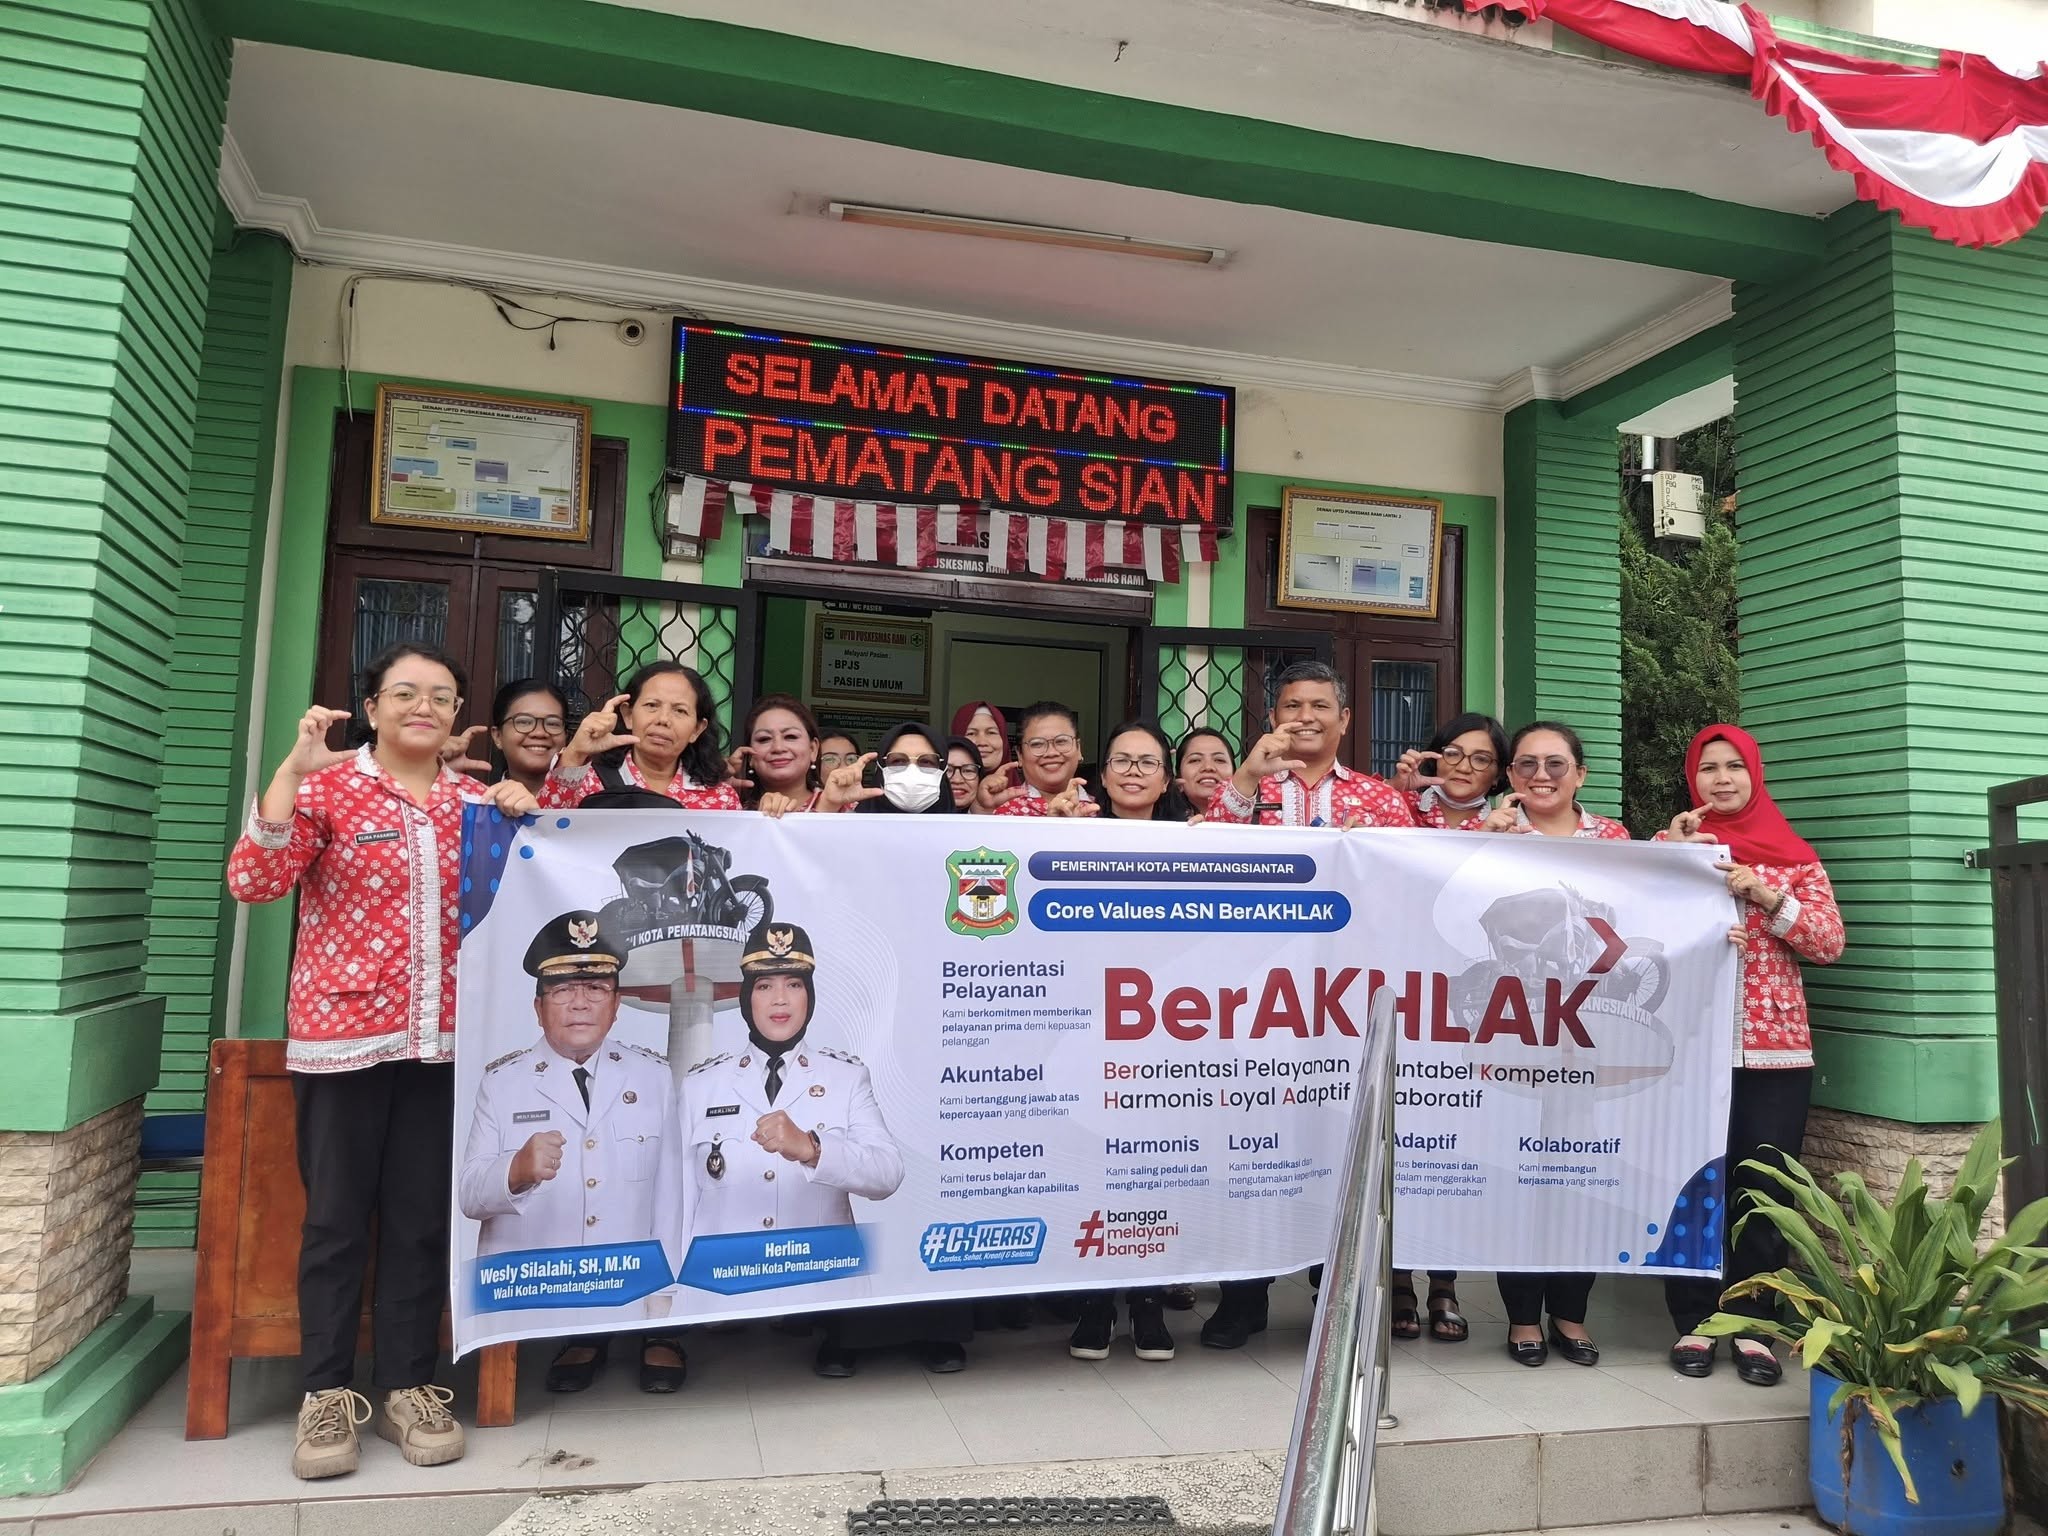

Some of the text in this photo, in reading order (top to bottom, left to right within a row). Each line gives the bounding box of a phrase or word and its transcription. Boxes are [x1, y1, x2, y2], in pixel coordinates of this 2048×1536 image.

[725, 351, 1179, 443] SELAMAT DATANG
[703, 417, 1228, 522] PEMATANG SIAN
[932, 557, 984, 572] USKESMAS
[1121, 574, 1144, 586] RAMI
[856, 630, 891, 644] PUSKESMAS
[834, 660, 860, 670] BPJS
[833, 676, 903, 690] PASIEN UMUM
[1051, 861, 1294, 874] PEMERINTAH KOTA PEMATANGSIANTAR
[1046, 901, 1334, 921] Core Values ASN BerAKHLAK
[638, 928, 664, 945] KOTA
[942, 960, 1065, 978] Berorientasi
[942, 982, 1047, 1002] Pelayanan
[942, 1007, 1092, 1018] Kami berkomitmen memberikan
[1104, 967, 1598, 1048] BerAKHLAK
[942, 1021, 1091, 1034] pelayanan prima demi kepuasan
[942, 1037, 990, 1048] pelanggan
[940, 1064, 1043, 1084] Akuntabel
[1104, 1058, 1595, 1088] Berorientasi Pelayanan ntabel Kompeten
[939, 1093, 1080, 1106] Kami bertanggung jawab atas
[1104, 1082, 1483, 1112] Harmonis Loyal Adaptif aboratif
[709, 1107, 737, 1115] HERLINA
[939, 1106, 1070, 1121] kepercayaan yang diberikan
[1105, 1136, 1200, 1155] Harmonis
[1229, 1132, 1279, 1153] Loyal
[1394, 1133, 1457, 1152] Adaptif
[1519, 1136, 1621, 1154] Kolaboratif
[940, 1141, 1044, 1163] Kompeten
[1106, 1164, 1208, 1177] Kami saling peduli dan
[1229, 1162, 1251, 1171] Kami
[1252, 1159, 1301, 1170] berdedikasi
[1411, 1160, 1460, 1170] berinovasi
[1461, 1161, 1479, 1171] dan
[1518, 1163, 1597, 1175] Kami membangun
[940, 1170, 1046, 1184] Kami terus belajar dan
[1106, 1177, 1210, 1191] menghargai perbedaan
[1229, 1173, 1293, 1186] mengutamakan
[1395, 1172, 1487, 1185] dalam menggerakkan
[1518, 1176, 1620, 1188] kerjasama yang sinergis
[940, 1183, 1079, 1198] mengembangkan kapabilitas
[1229, 1186, 1303, 1199] bangsa dan negara
[1394, 1185, 1483, 1198] nghadapi perubahan
[1107, 1208, 1168, 1225] bangga
[1107, 1222, 1179, 1242] melayani
[765, 1240, 811, 1258] Herlina
[1107, 1241, 1165, 1258] bangsa
[480, 1255, 641, 1285] Wesly Silalahi, SH, M.Kn
[713, 1256, 860, 1279] Wakil Wali Kota Pematangsiantar
[493, 1278, 625, 1300] Wali Kota Pematangsiantar
